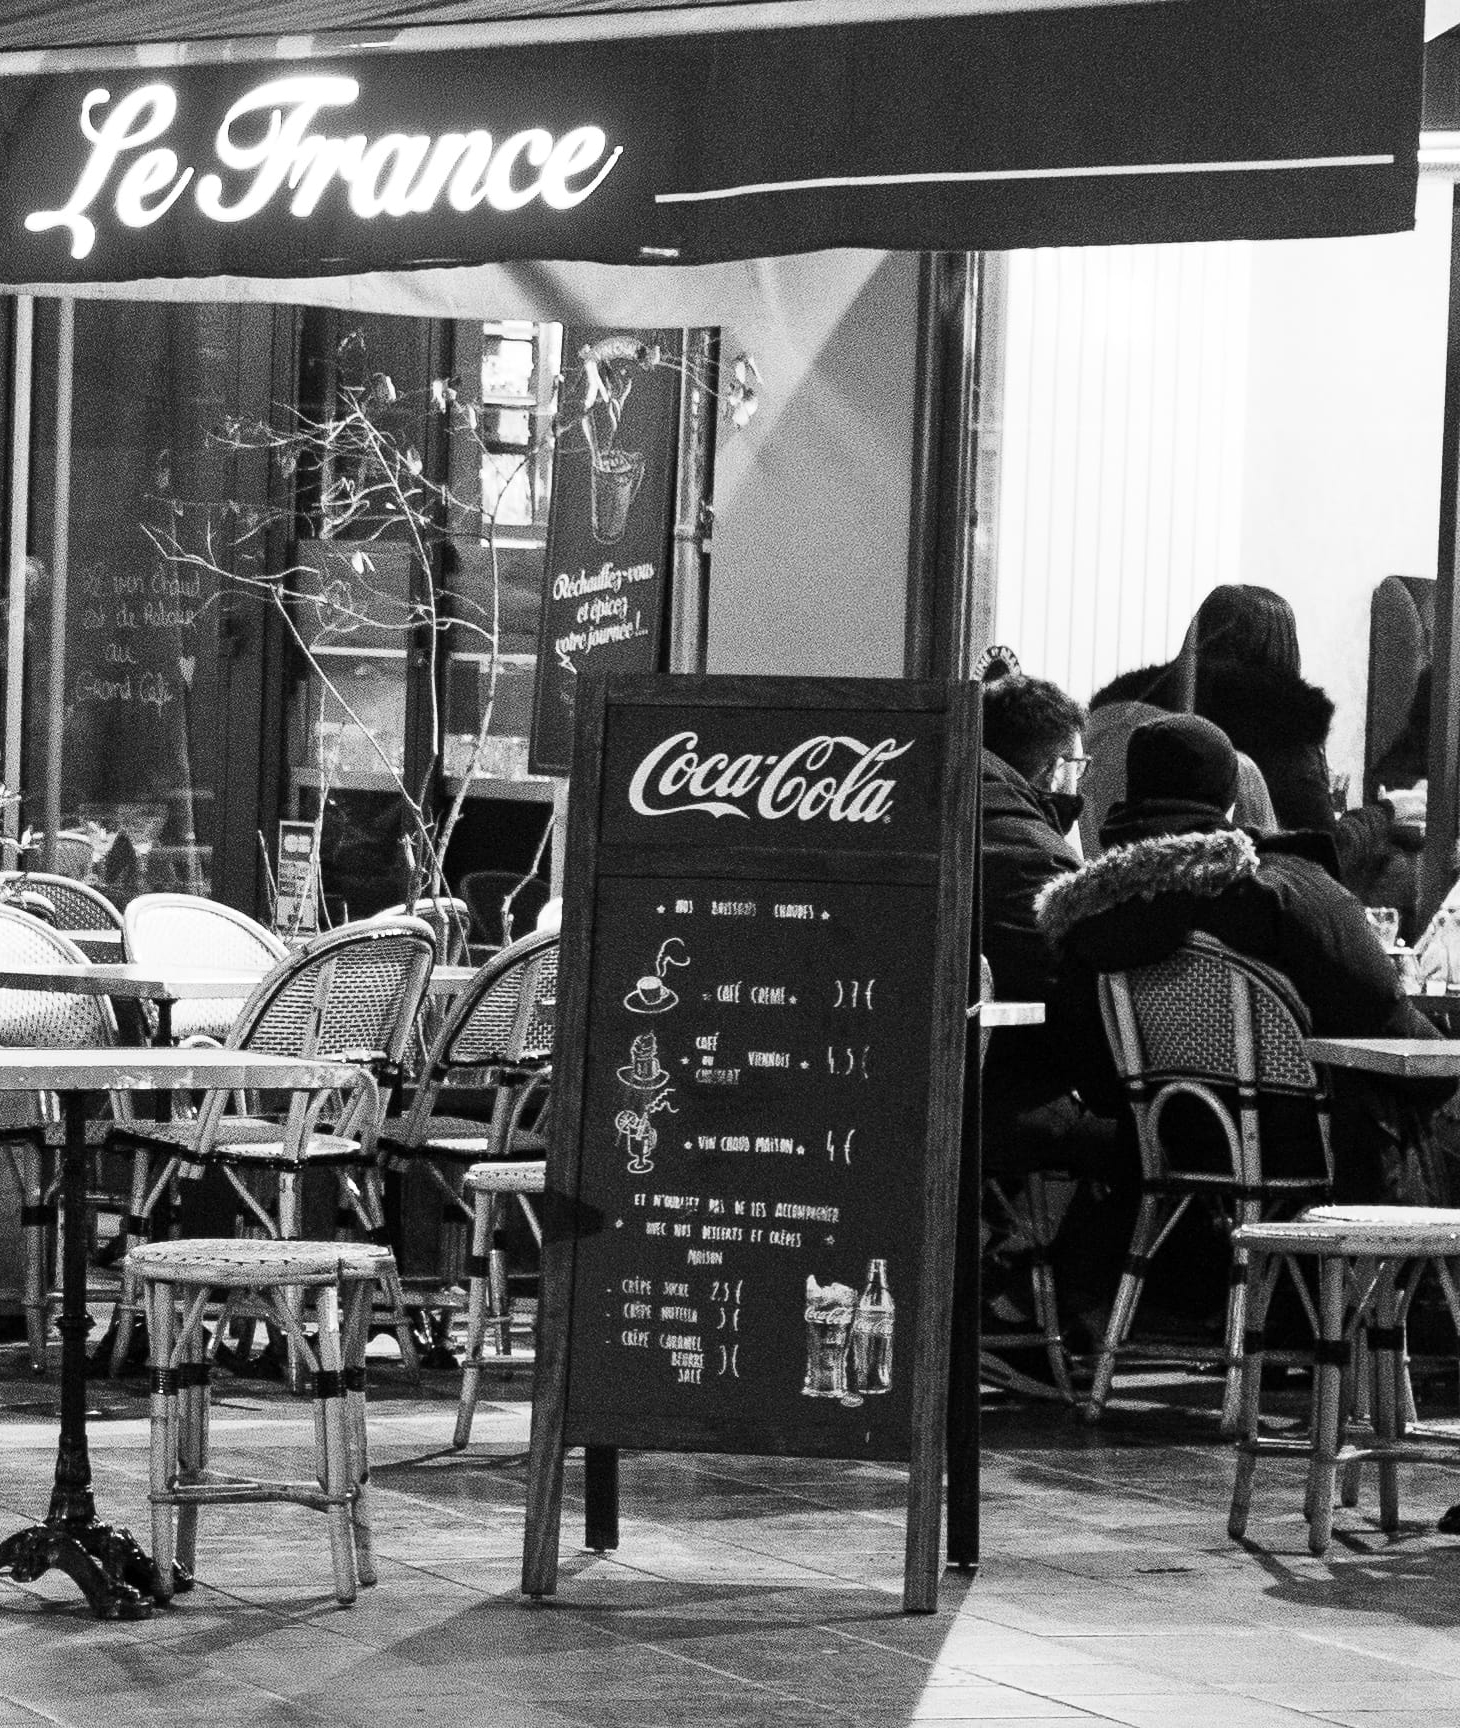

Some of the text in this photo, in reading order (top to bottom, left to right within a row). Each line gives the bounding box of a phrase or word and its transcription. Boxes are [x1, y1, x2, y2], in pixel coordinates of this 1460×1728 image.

[24, 75, 624, 260] Le France
[629, 731, 915, 823] Coca-Cola
